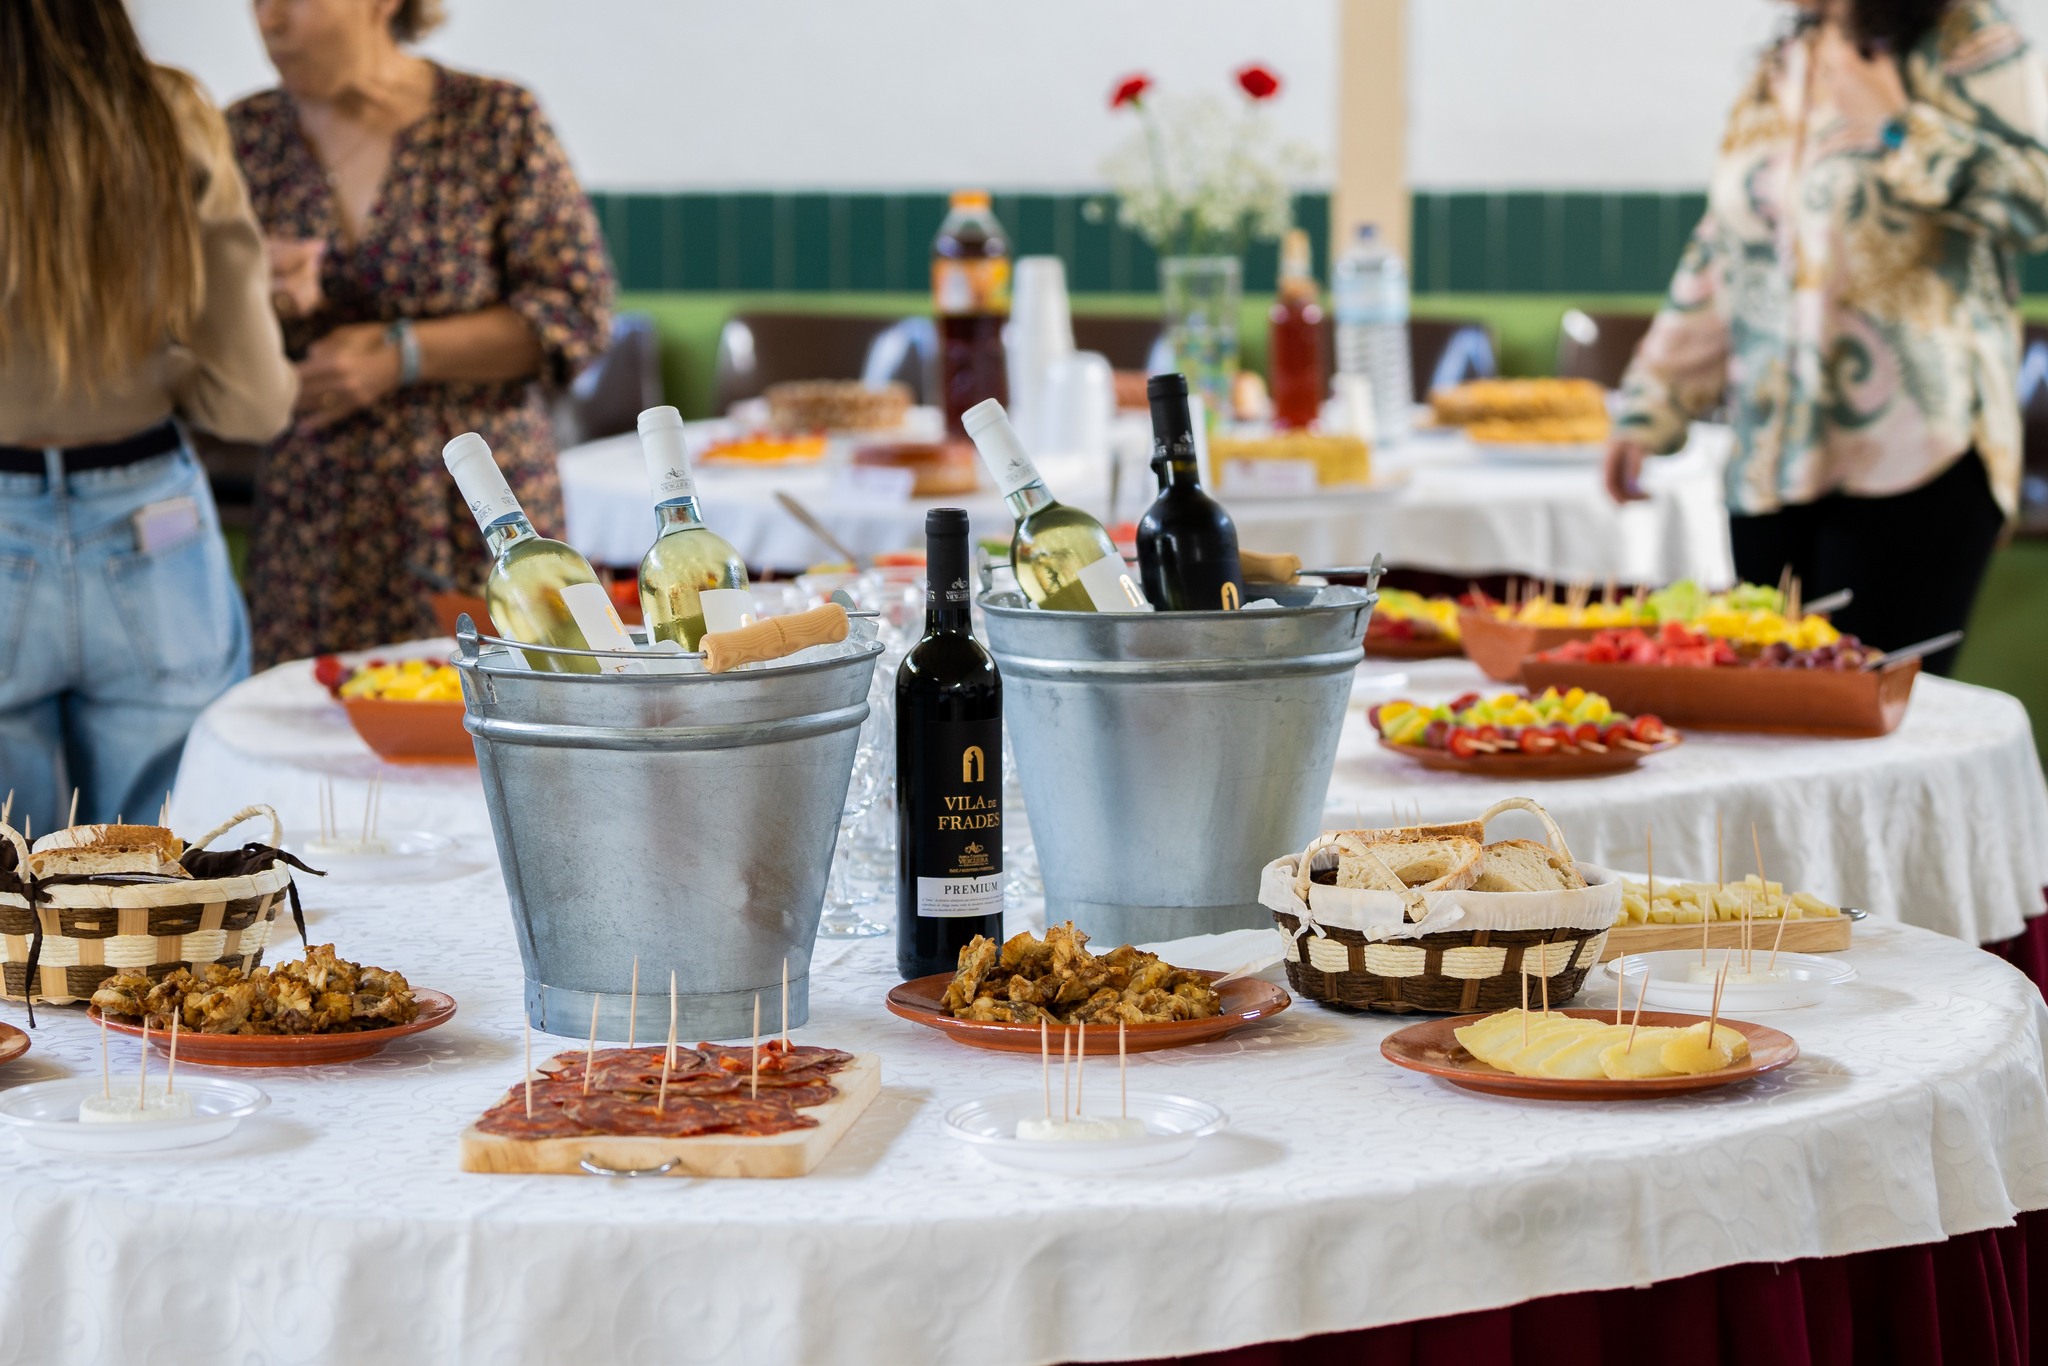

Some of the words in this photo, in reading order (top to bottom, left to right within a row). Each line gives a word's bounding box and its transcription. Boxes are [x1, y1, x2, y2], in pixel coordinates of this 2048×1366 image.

[944, 795, 986, 811] VILA
[988, 799, 997, 809] DE
[937, 812, 1000, 830] FRADES
[944, 881, 998, 895] PREMIUM
